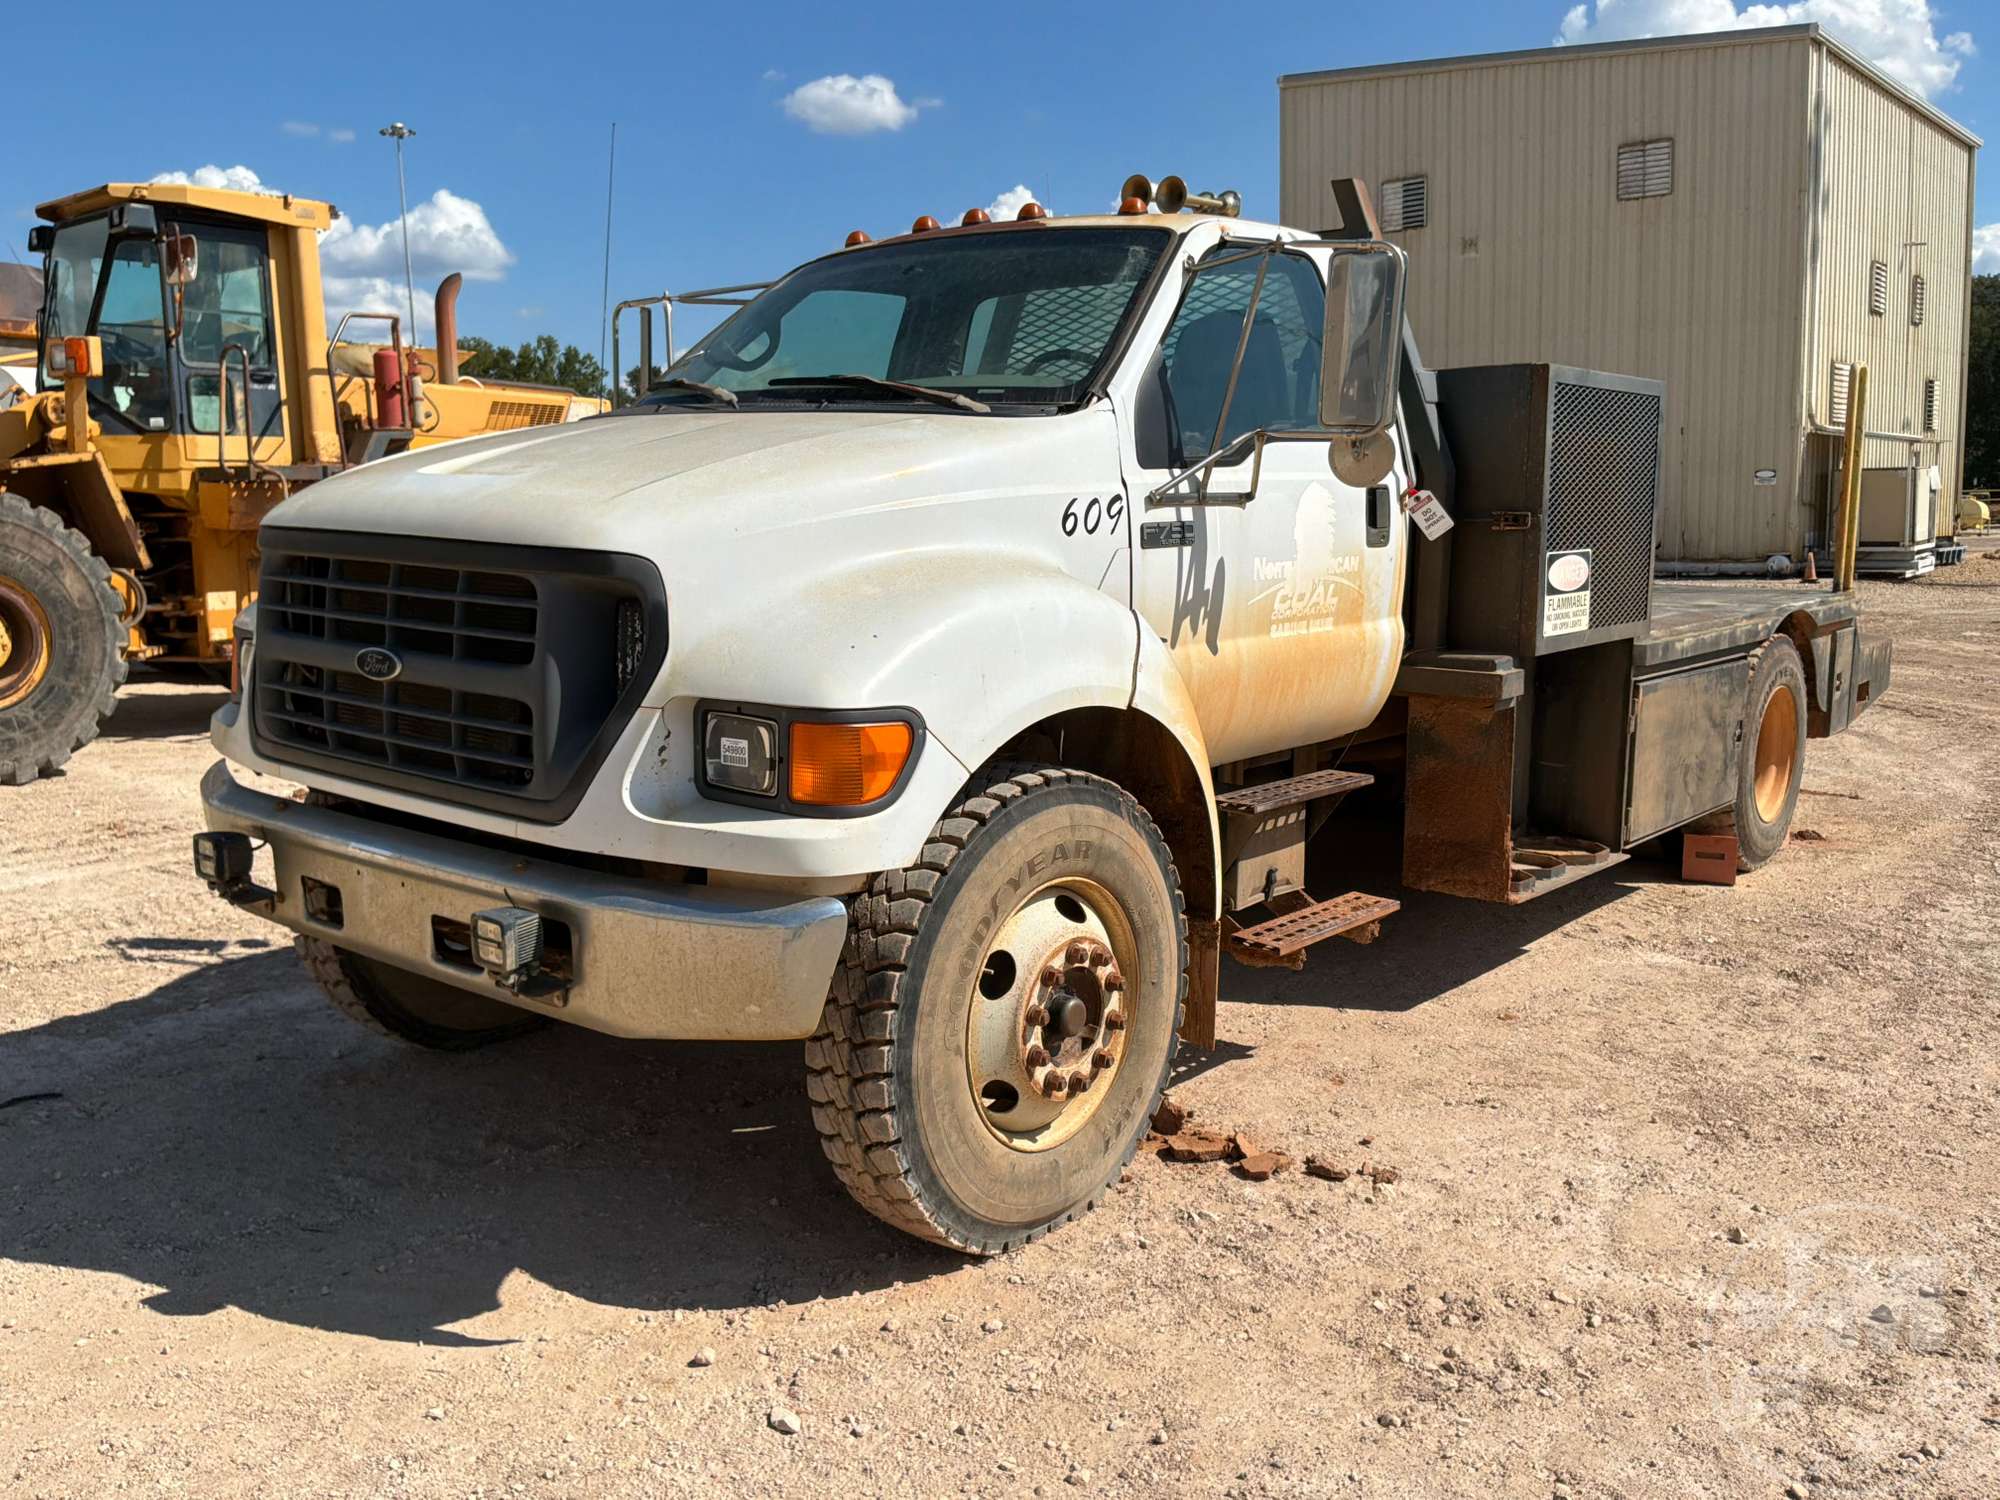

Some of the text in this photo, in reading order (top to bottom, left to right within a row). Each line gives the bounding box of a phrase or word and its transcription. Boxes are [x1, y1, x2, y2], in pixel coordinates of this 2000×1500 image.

[1061, 493, 1124, 537] 609
[1274, 580, 1339, 610] COAL
[1547, 594, 1588, 611] FLAMMABLE
[364, 653, 390, 674] Ford
